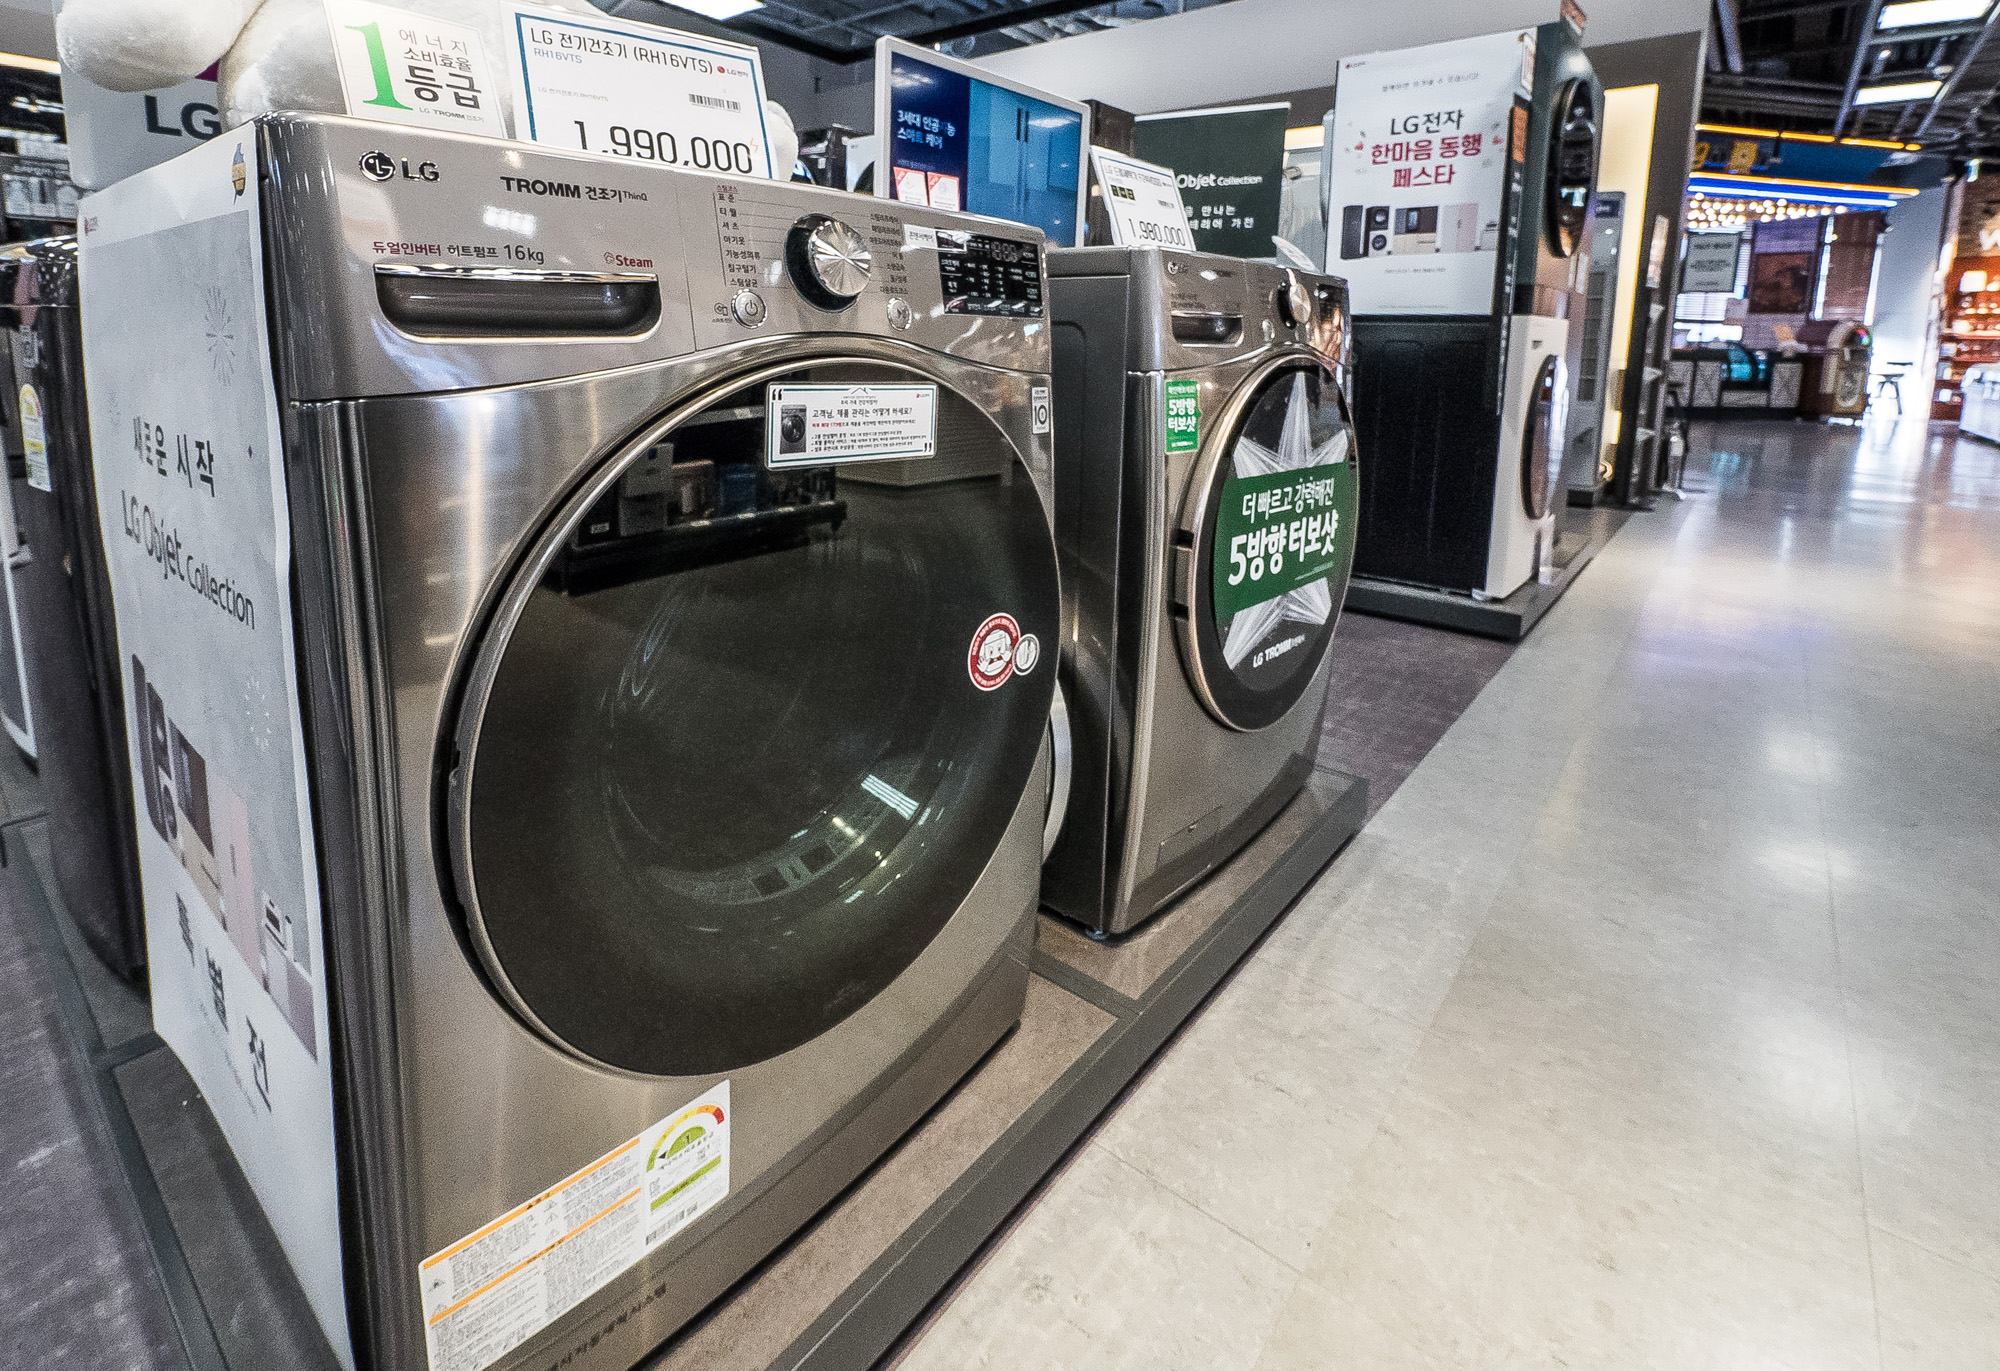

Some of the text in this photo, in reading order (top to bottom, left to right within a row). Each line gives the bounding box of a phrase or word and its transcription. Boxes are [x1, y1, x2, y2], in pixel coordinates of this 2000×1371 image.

[403, 48, 472, 72] 소비효율
[530, 28, 713, 74] LG 전기건조기 (RH16VTS)
[534, 48, 582, 64] RH16VTS
[344, 22, 413, 111] 1
[405, 65, 482, 109] 등급
[144, 95, 222, 140] LG
[433, 109, 465, 119] TROMM
[1391, 109, 1464, 135] LG전자
[1371, 133, 1482, 165] 한마음 동행
[401, 157, 441, 182] LG
[1176, 173, 1217, 190] Objet
[1217, 176, 1263, 186] Collection
[1393, 164, 1455, 188] 페스타
[500, 176, 649, 203] TROMM 건조기 ThinQ
[724, 236, 745, 245] 아기옷
[1128, 219, 1186, 247] 1,980,000
[371, 241, 545, 265] 듀얼인버터 히트펌프 16kg
[615, 254, 653, 268] Steam
[726, 250, 760, 260] 기능성의류
[837, 409, 849, 418] 제품
[852, 408, 870, 418] 관리는
[872, 408, 890, 416] 어떻게
[1169, 398, 1196, 416] 5방향
[1168, 416, 1197, 432] 터보샷
[133, 416, 167, 477] 새로운
[1242, 476, 1336, 523] 더 빠르고 강력해진
[121, 489, 255, 629] LG Objet Collection
[1227, 509, 1339, 586] 5방향 터보샷
[1253, 652, 1264, 668] LG
[1265, 636, 1292, 660] TROMM
